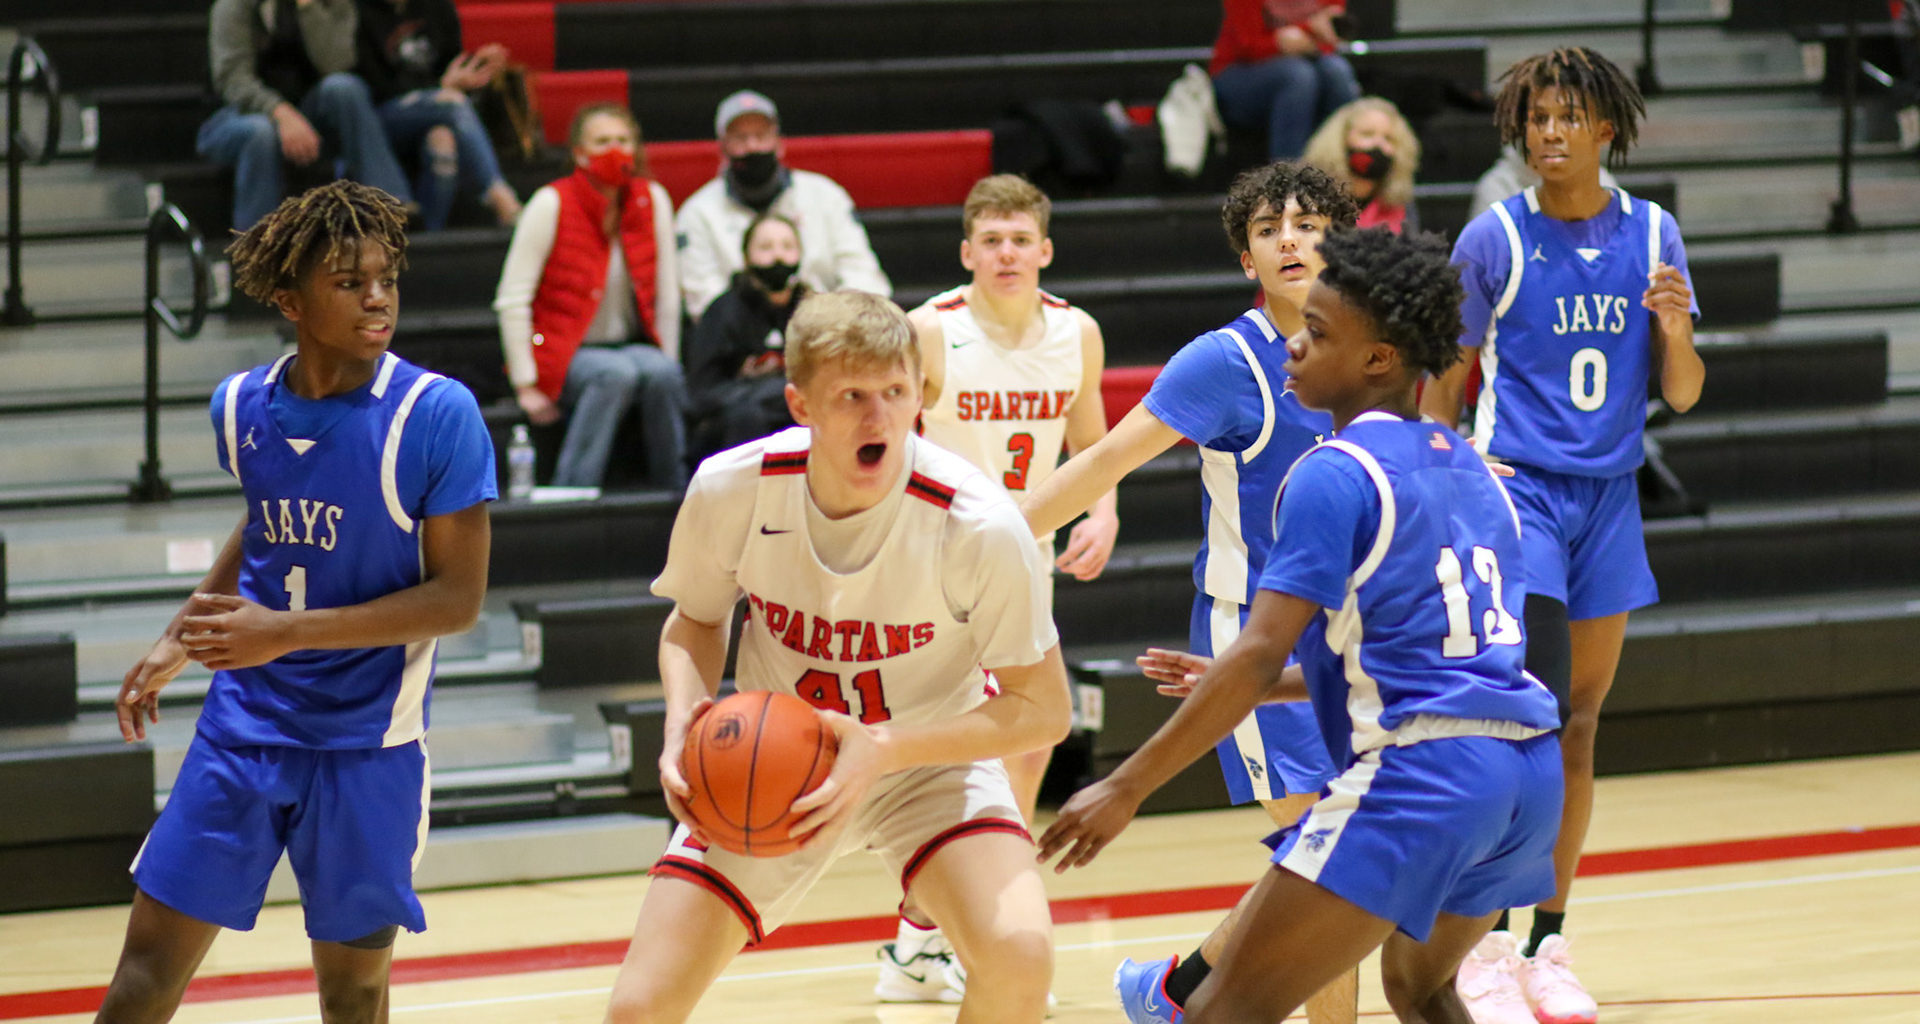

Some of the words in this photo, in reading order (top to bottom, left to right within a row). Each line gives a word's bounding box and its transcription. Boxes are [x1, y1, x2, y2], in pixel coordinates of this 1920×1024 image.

[1552, 293, 1629, 335] JAYS
[957, 390, 1074, 420] SPARTAN
[1569, 346, 1608, 412] 0
[1003, 432, 1034, 490] 3
[261, 498, 344, 552] JAYS
[284, 565, 307, 611] 1
[795, 668, 892, 725] 41
